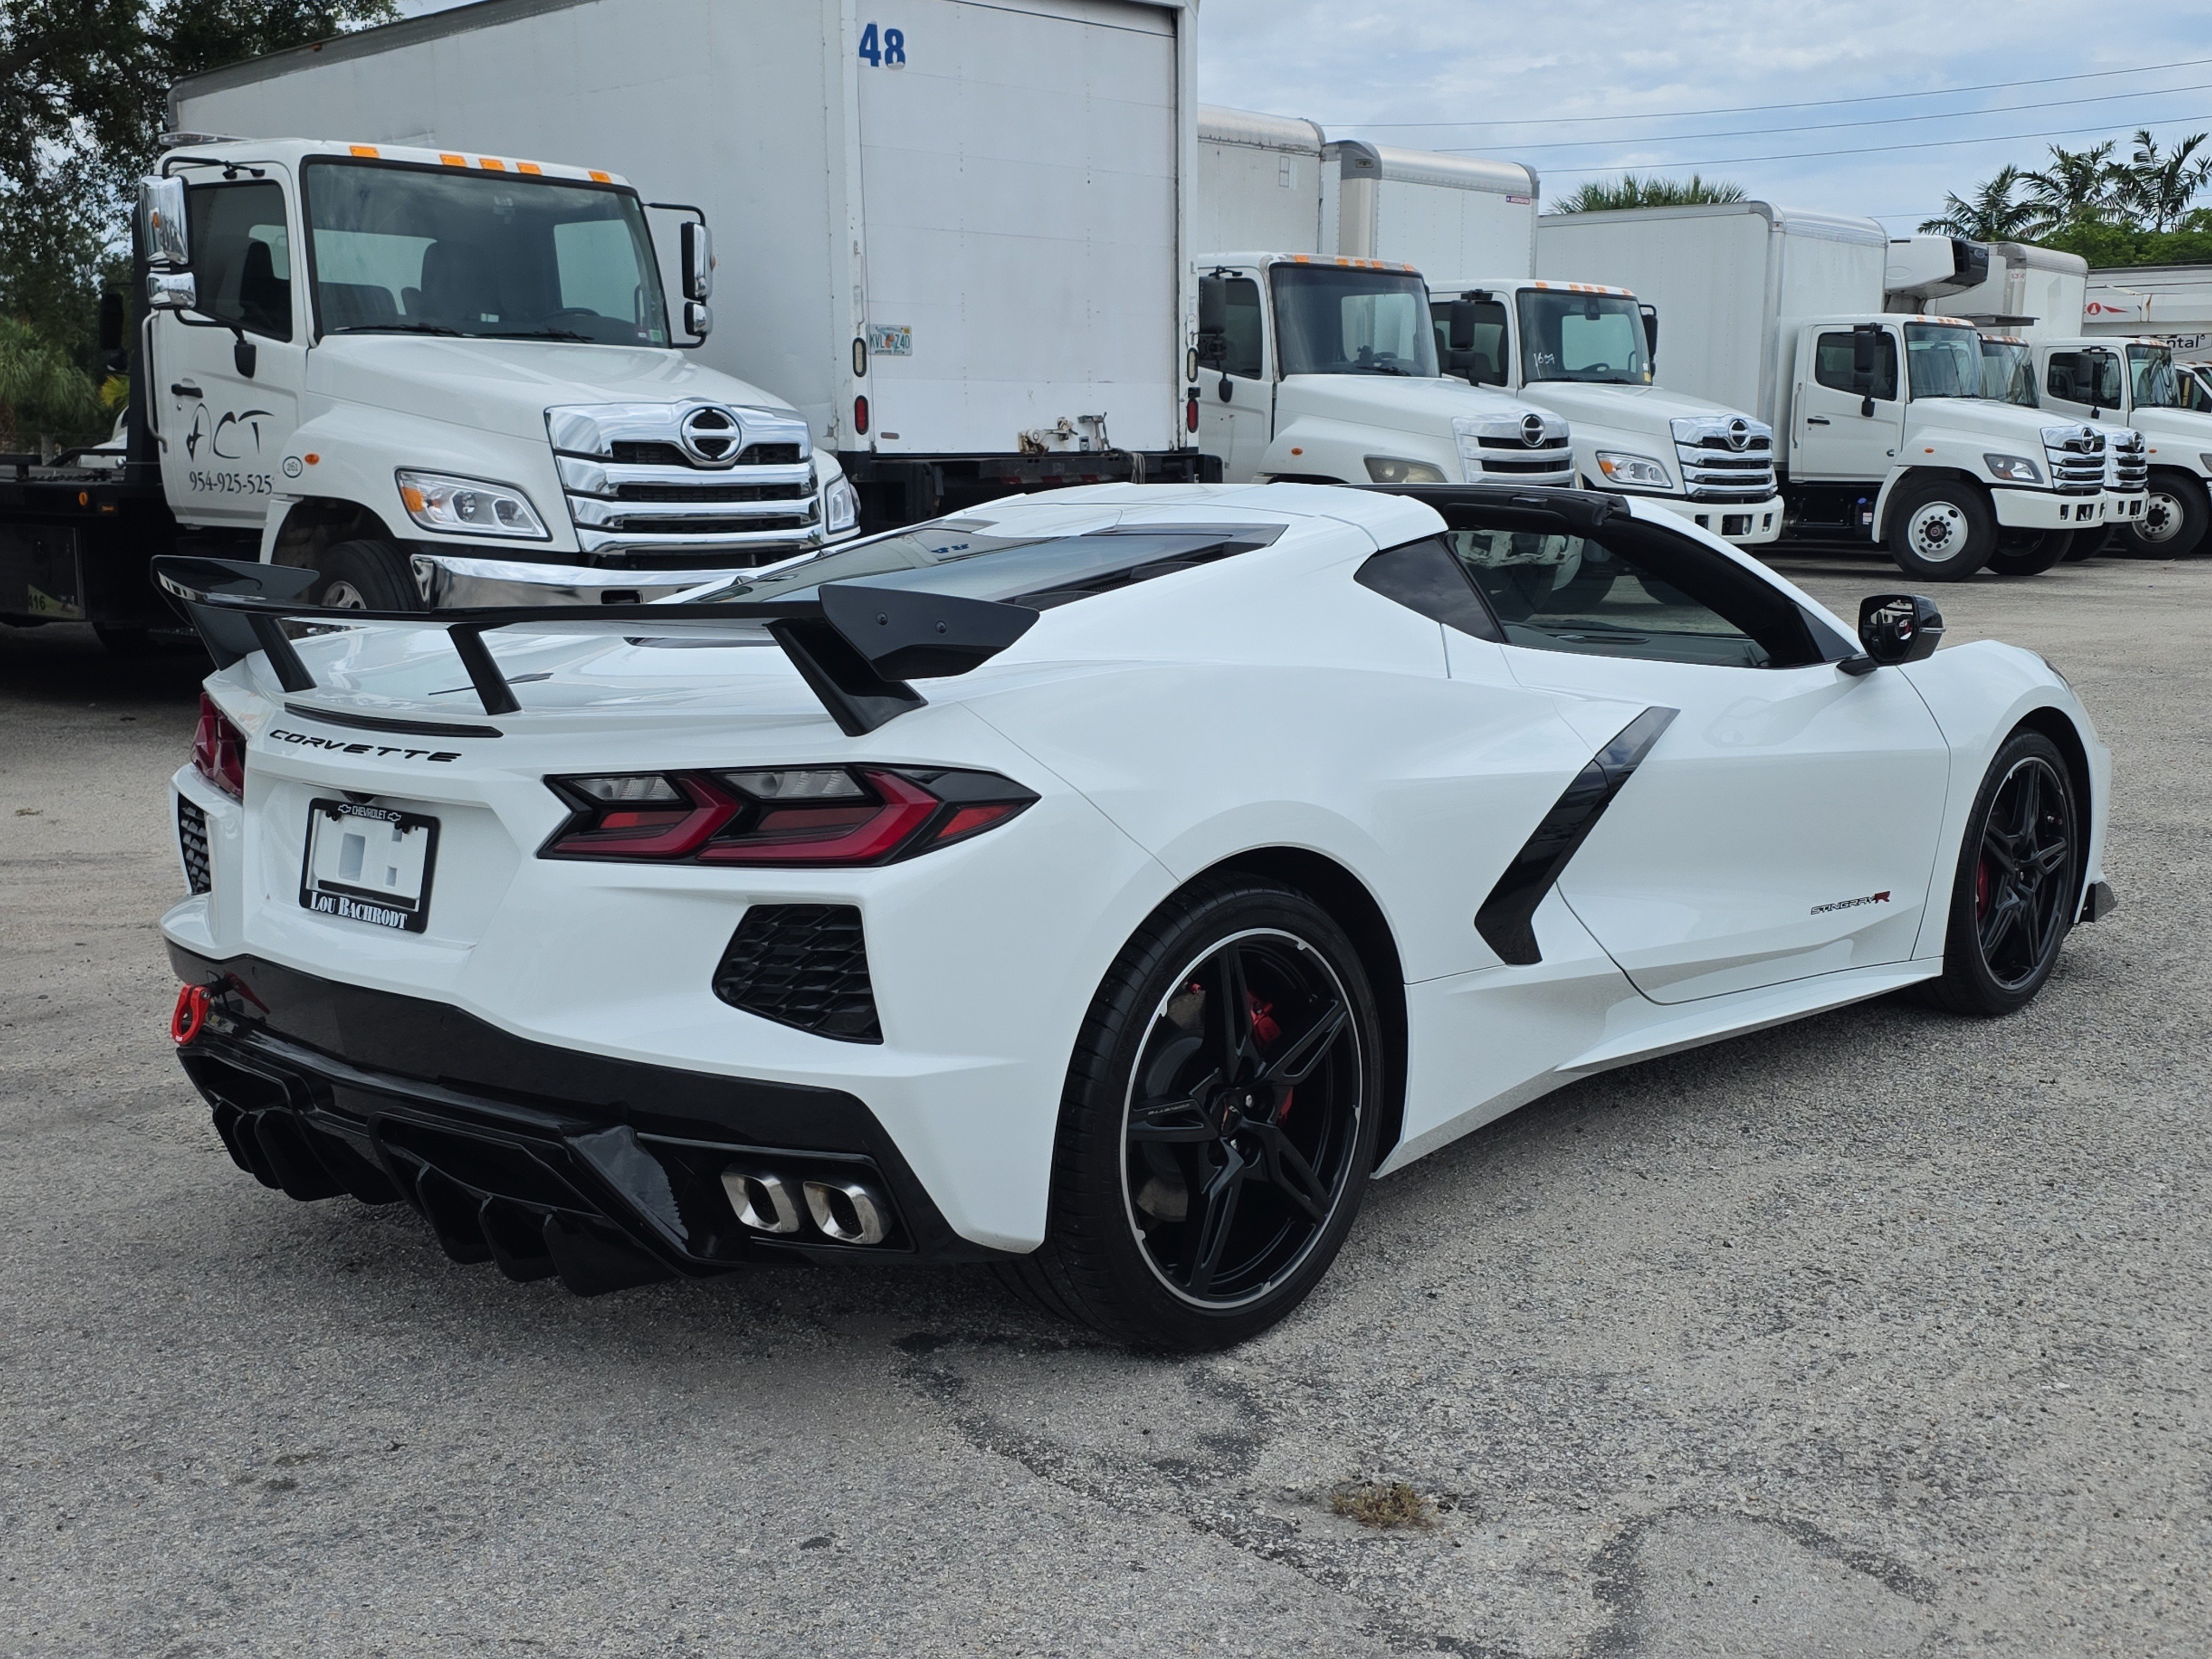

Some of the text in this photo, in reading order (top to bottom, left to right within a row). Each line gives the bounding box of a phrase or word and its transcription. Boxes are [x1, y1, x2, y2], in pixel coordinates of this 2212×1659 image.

[859, 23, 905, 68] 48
[895, 334, 910, 349] Z40
[2159, 335, 2199, 348] ntal
[186, 402, 276, 462] ACT
[190, 470, 274, 495] 954-925-525
[269, 729, 462, 762] CORVETTE
[352, 805, 388, 820] CHEVROLET
[338, 897, 408, 930] BACHRODT
